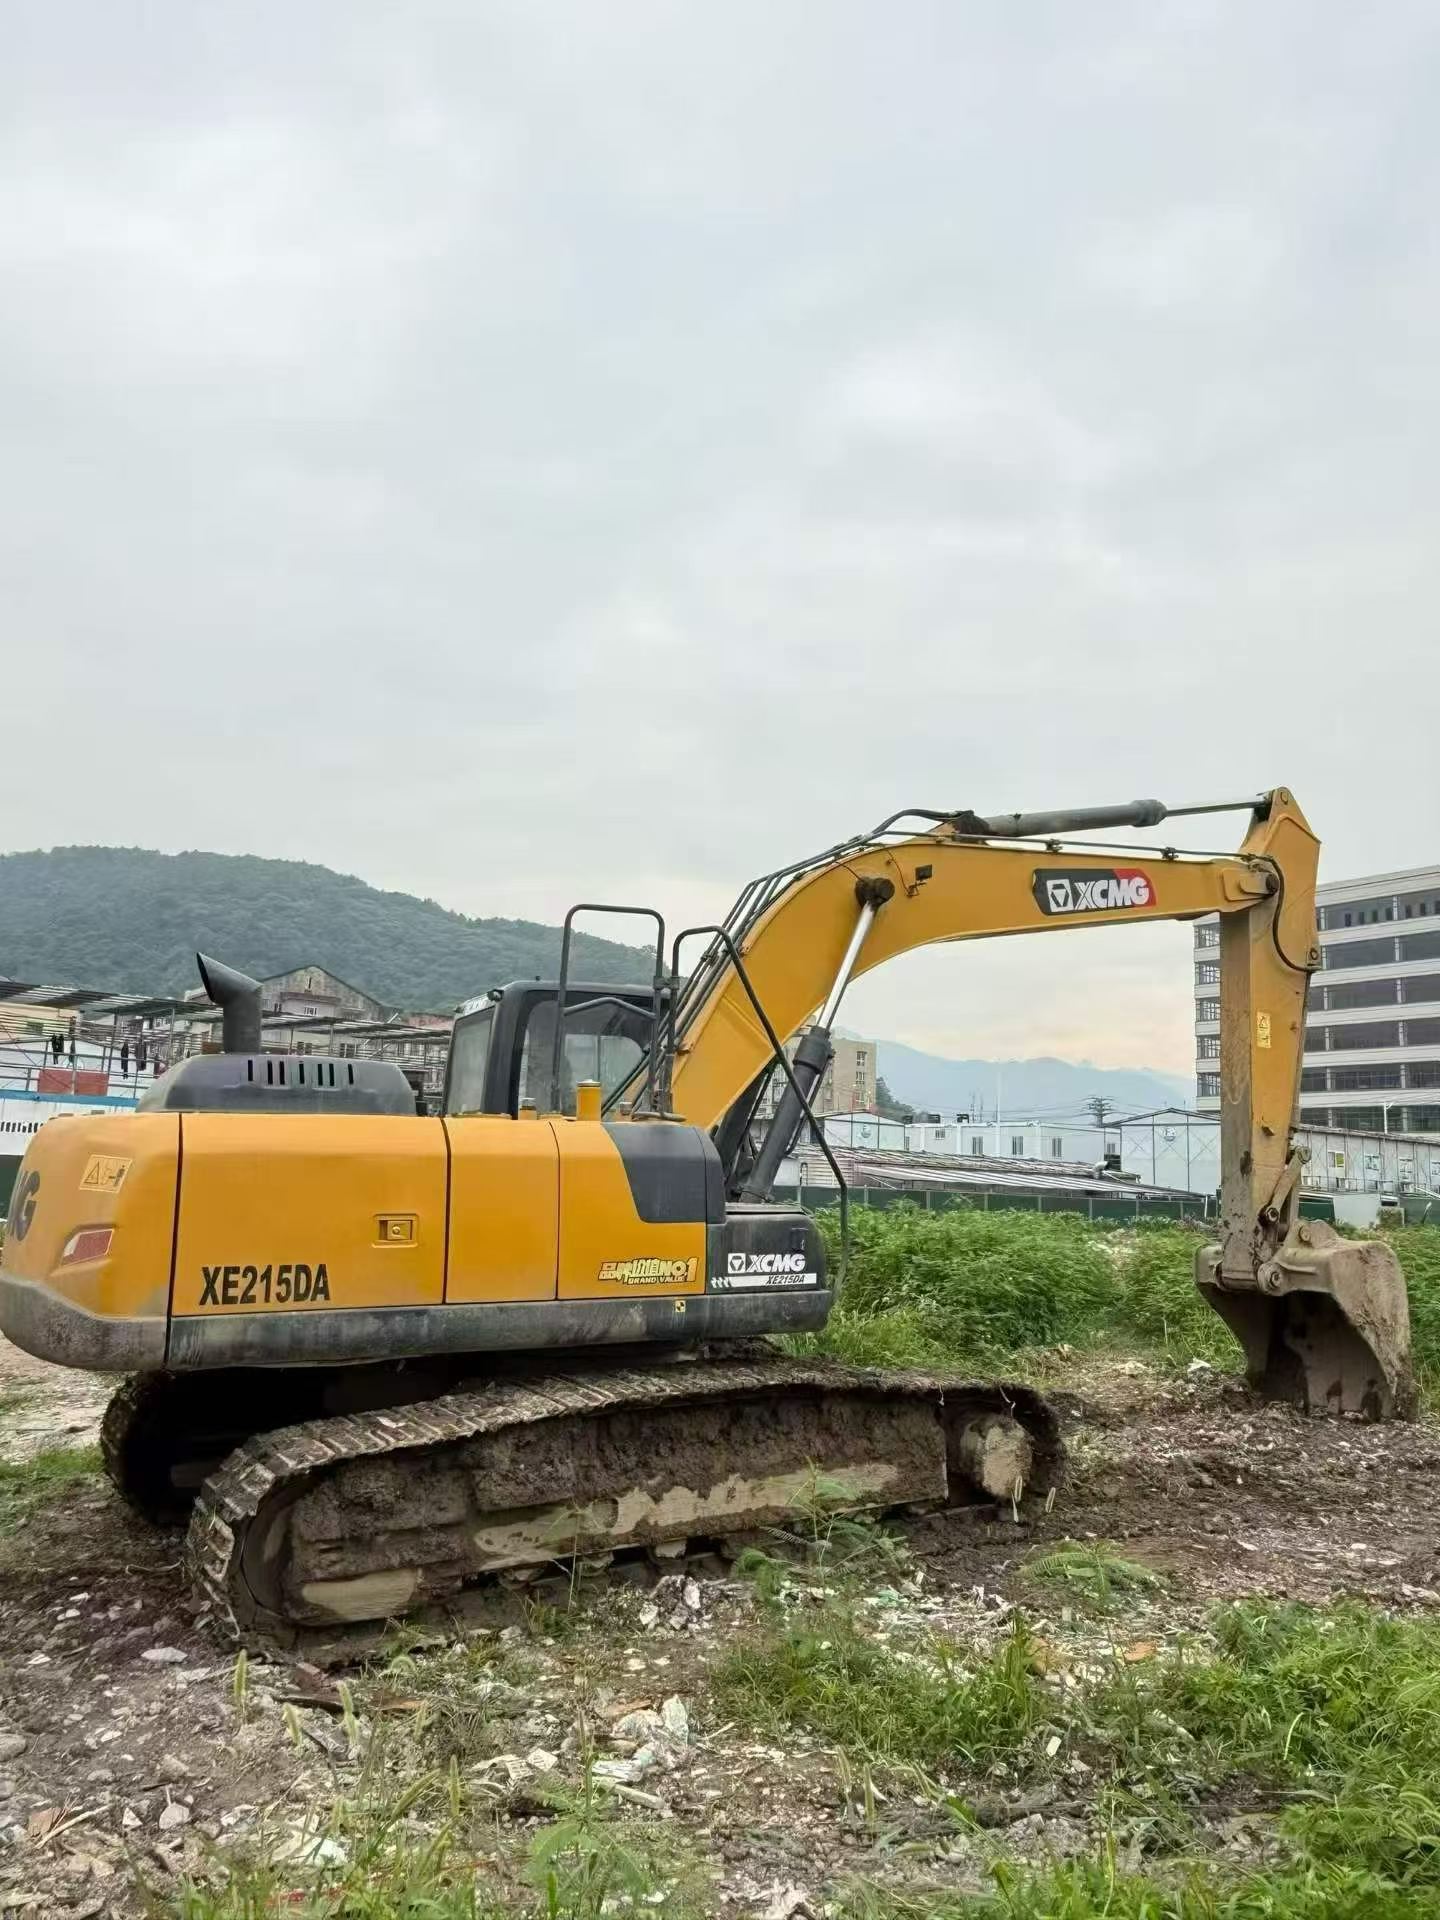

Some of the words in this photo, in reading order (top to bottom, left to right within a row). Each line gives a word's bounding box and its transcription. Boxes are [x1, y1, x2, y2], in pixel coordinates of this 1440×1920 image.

[1073, 876, 1149, 911] XCMG
[747, 1253, 805, 1273] XCMG
[199, 1263, 331, 1306] XE215DA
[766, 1274, 805, 1285] XE215DA
